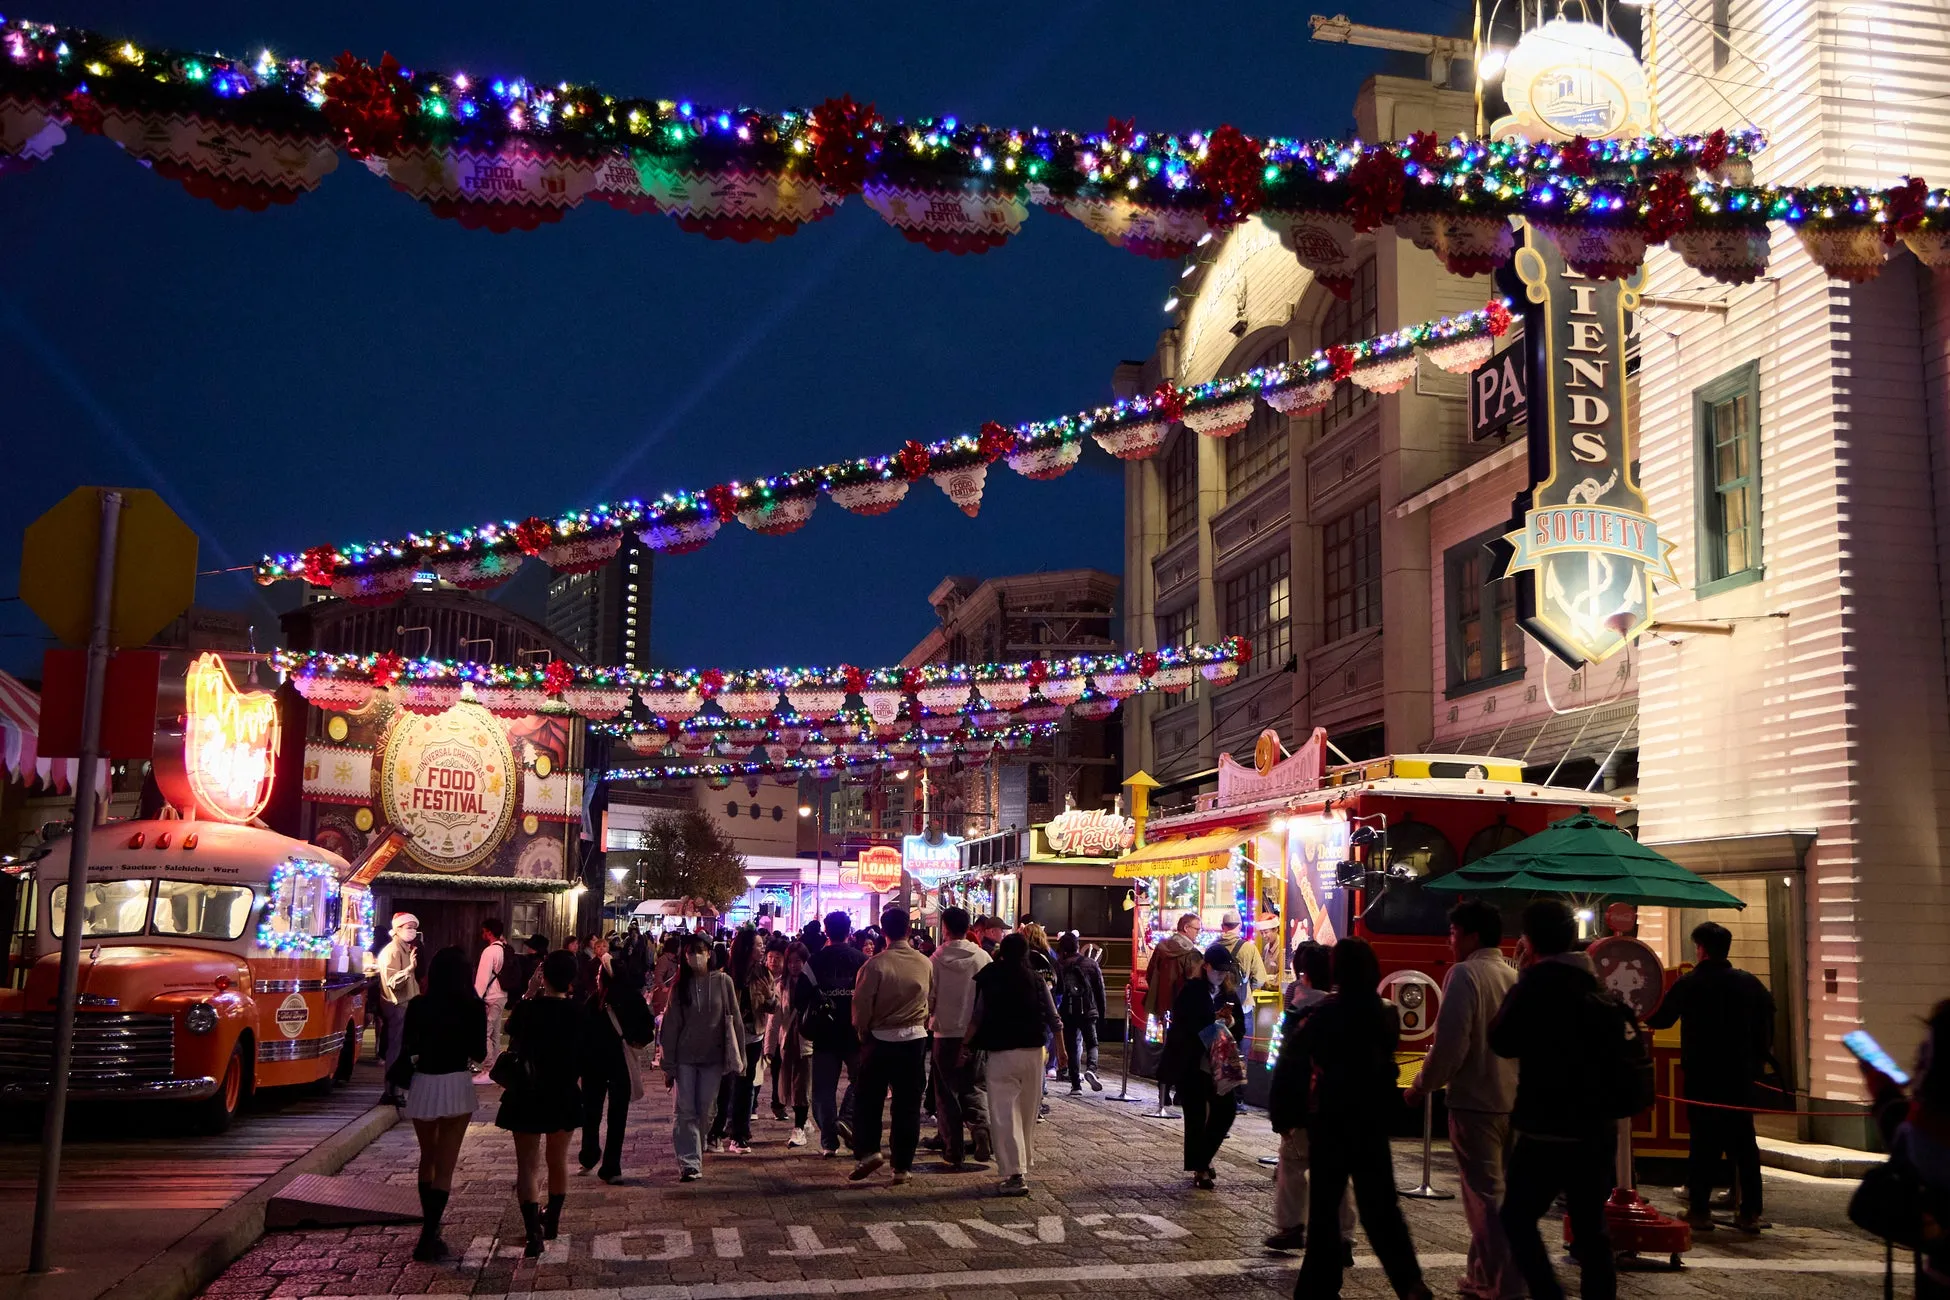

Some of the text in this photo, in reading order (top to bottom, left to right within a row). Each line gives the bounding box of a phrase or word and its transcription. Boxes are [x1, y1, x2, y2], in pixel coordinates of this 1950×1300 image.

[474, 165, 514, 179] FOOD
[607, 165, 637, 177] FOOD
[464, 176, 528, 192] FESTIVAL
[929, 201, 963, 213] FOOD
[924, 210, 974, 224] FESTIVAL
[1300, 234, 1334, 248] FOOD
[1561, 265, 1609, 464] IENDS
[1475, 357, 1526, 430] PA
[950, 486, 979, 497] FESTIVAL
[953, 480, 973, 490] FOOD
[1536, 511, 1647, 552] SOCIETY
[417, 572, 437, 580] OTEL
[417, 746, 485, 779] UNIVERSAL CHRISTMAS
[427, 766, 476, 792] FOOD
[413, 788, 488, 814] FESTIVAL
[1064, 810, 1123, 836] Trolley
[1064, 829, 1117, 851] Treats
[164, 864, 205, 872] Salchicha
[213, 866, 239, 874] Wurst
[863, 862, 902, 876] LOANS
[460, 1214, 1191, 1268] CAUTION
